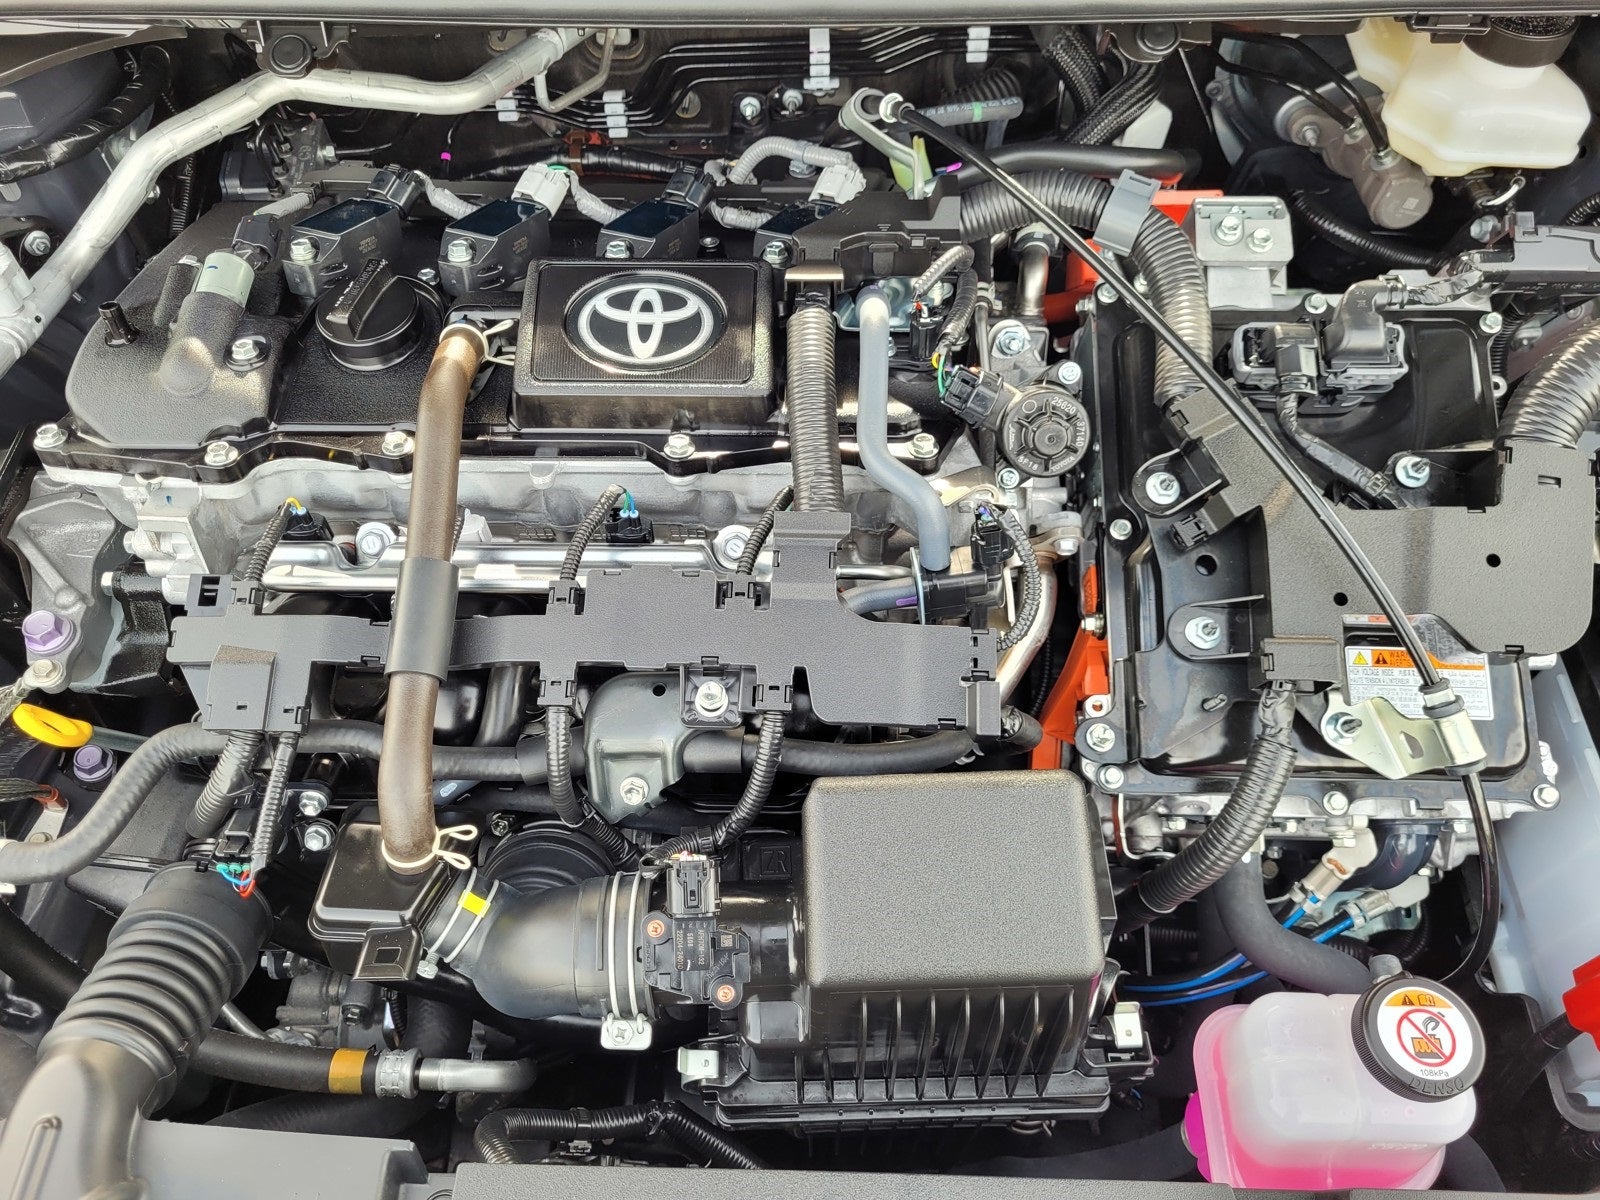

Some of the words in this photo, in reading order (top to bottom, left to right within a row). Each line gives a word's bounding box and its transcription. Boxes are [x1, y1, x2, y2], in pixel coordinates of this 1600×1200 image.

[1051, 396, 1077, 415] 25620
[1075, 421, 1086, 447] 37140
[1050, 455, 1075, 472] TOYOTA
[763, 850, 788, 873] ZR
[1420, 1069, 1450, 1078] 108kPa
[1409, 1077, 1464, 1095] DENSO
